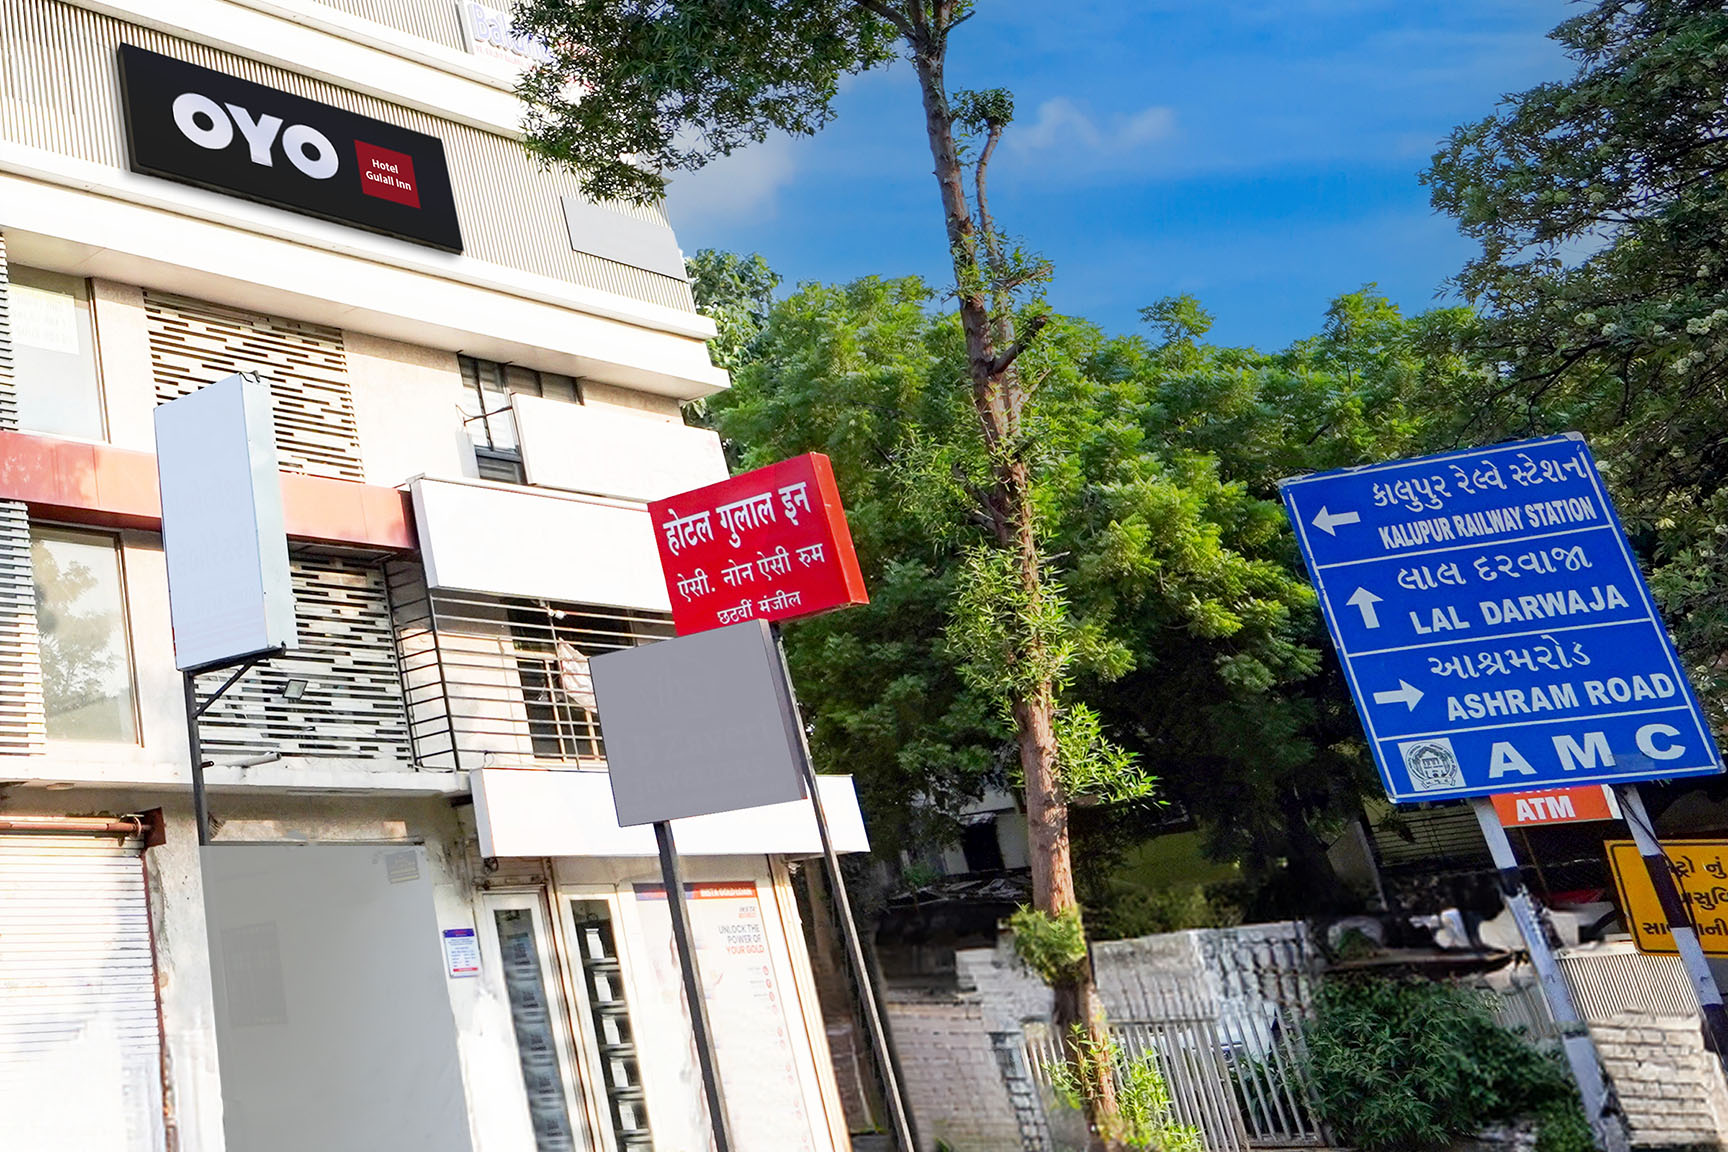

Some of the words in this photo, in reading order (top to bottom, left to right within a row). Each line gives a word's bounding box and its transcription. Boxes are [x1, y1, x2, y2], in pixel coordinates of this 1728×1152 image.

[172, 92, 339, 180] OYO
[365, 170, 394, 187] Gulall
[396, 178, 412, 191] Inn
[371, 158, 399, 174] Hotel
[1373, 475, 1452, 513] કાલુપુર
[1455, 461, 1507, 496] રેલ્વે
[1510, 452, 1587, 485] સ્ટેશન
[663, 508, 715, 557] होटल
[716, 492, 777, 548] गुलाल
[778, 481, 812, 526] इन
[1377, 515, 1453, 550] KALUPUR
[1455, 507, 1523, 538] RAILWAY
[1528, 496, 1597, 527] STATION
[677, 567, 716, 603] ऐसी.
[721, 559, 755, 588] नोन
[756, 545, 793, 581] ऐसी
[1397, 559, 1467, 591] લાલ
[1473, 544, 1593, 584] દરવાજા
[758, 589, 802, 614] मंजील
[1409, 603, 1470, 635] LAL
[1479, 584, 1629, 626] DARWAJA
[1427, 634, 1592, 681] આશ્રમરોડ
[1447, 679, 1580, 722] ASHRAM
[1585, 673, 1676, 706] ROAD
[1515, 795, 1576, 822] ATM
